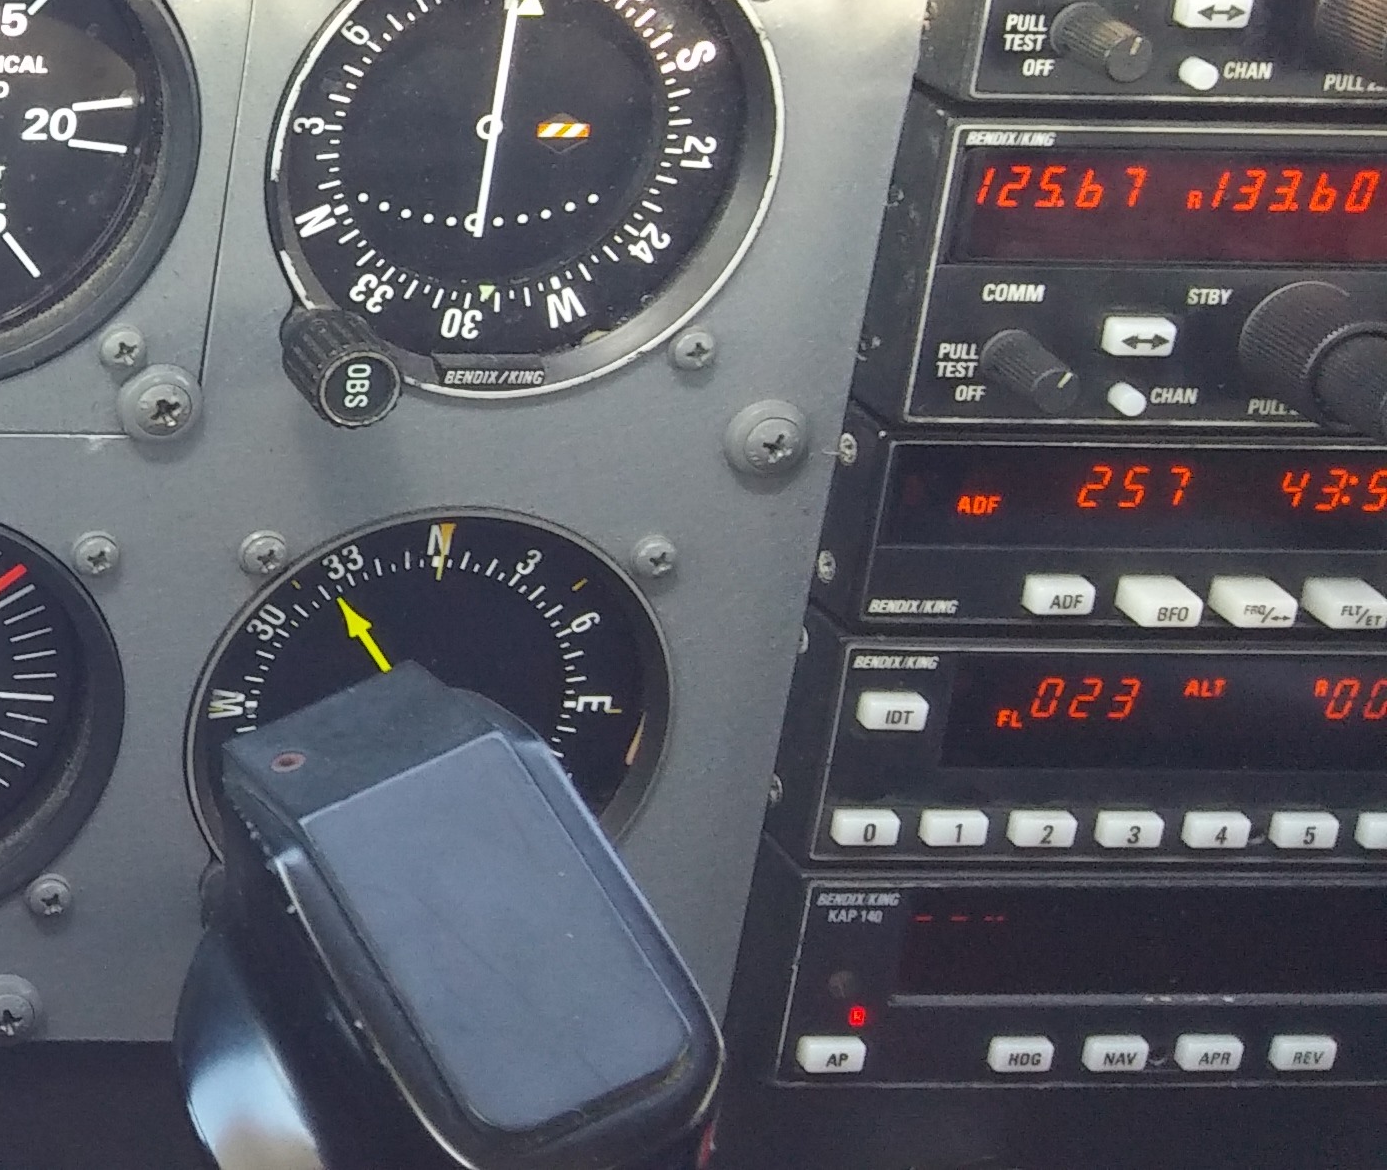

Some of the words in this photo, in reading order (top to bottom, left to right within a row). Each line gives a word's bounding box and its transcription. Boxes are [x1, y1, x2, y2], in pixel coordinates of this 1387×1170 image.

[1223, 61, 1273, 81] CHAN
[21, 107, 77, 142] 20
[982, 283, 1046, 303] COMM
[1187, 288, 1233, 306] STBY
[444, 370, 545, 386] BENDIX/KING
[1076, 466, 1193, 509] 257
[957, 494, 1002, 515] ADF
[867, 598, 959, 615] BENDIX/KING
[1049, 593, 1084, 610] ADF
[1156, 606, 1190, 623] BFO
[1183, 679, 1227, 698] ALT
[1030, 677, 1142, 721] 023
[885, 710, 915, 726] IDT
[826, 1052, 848, 1068] AP
[1103, 1052, 1138, 1067] NAV
